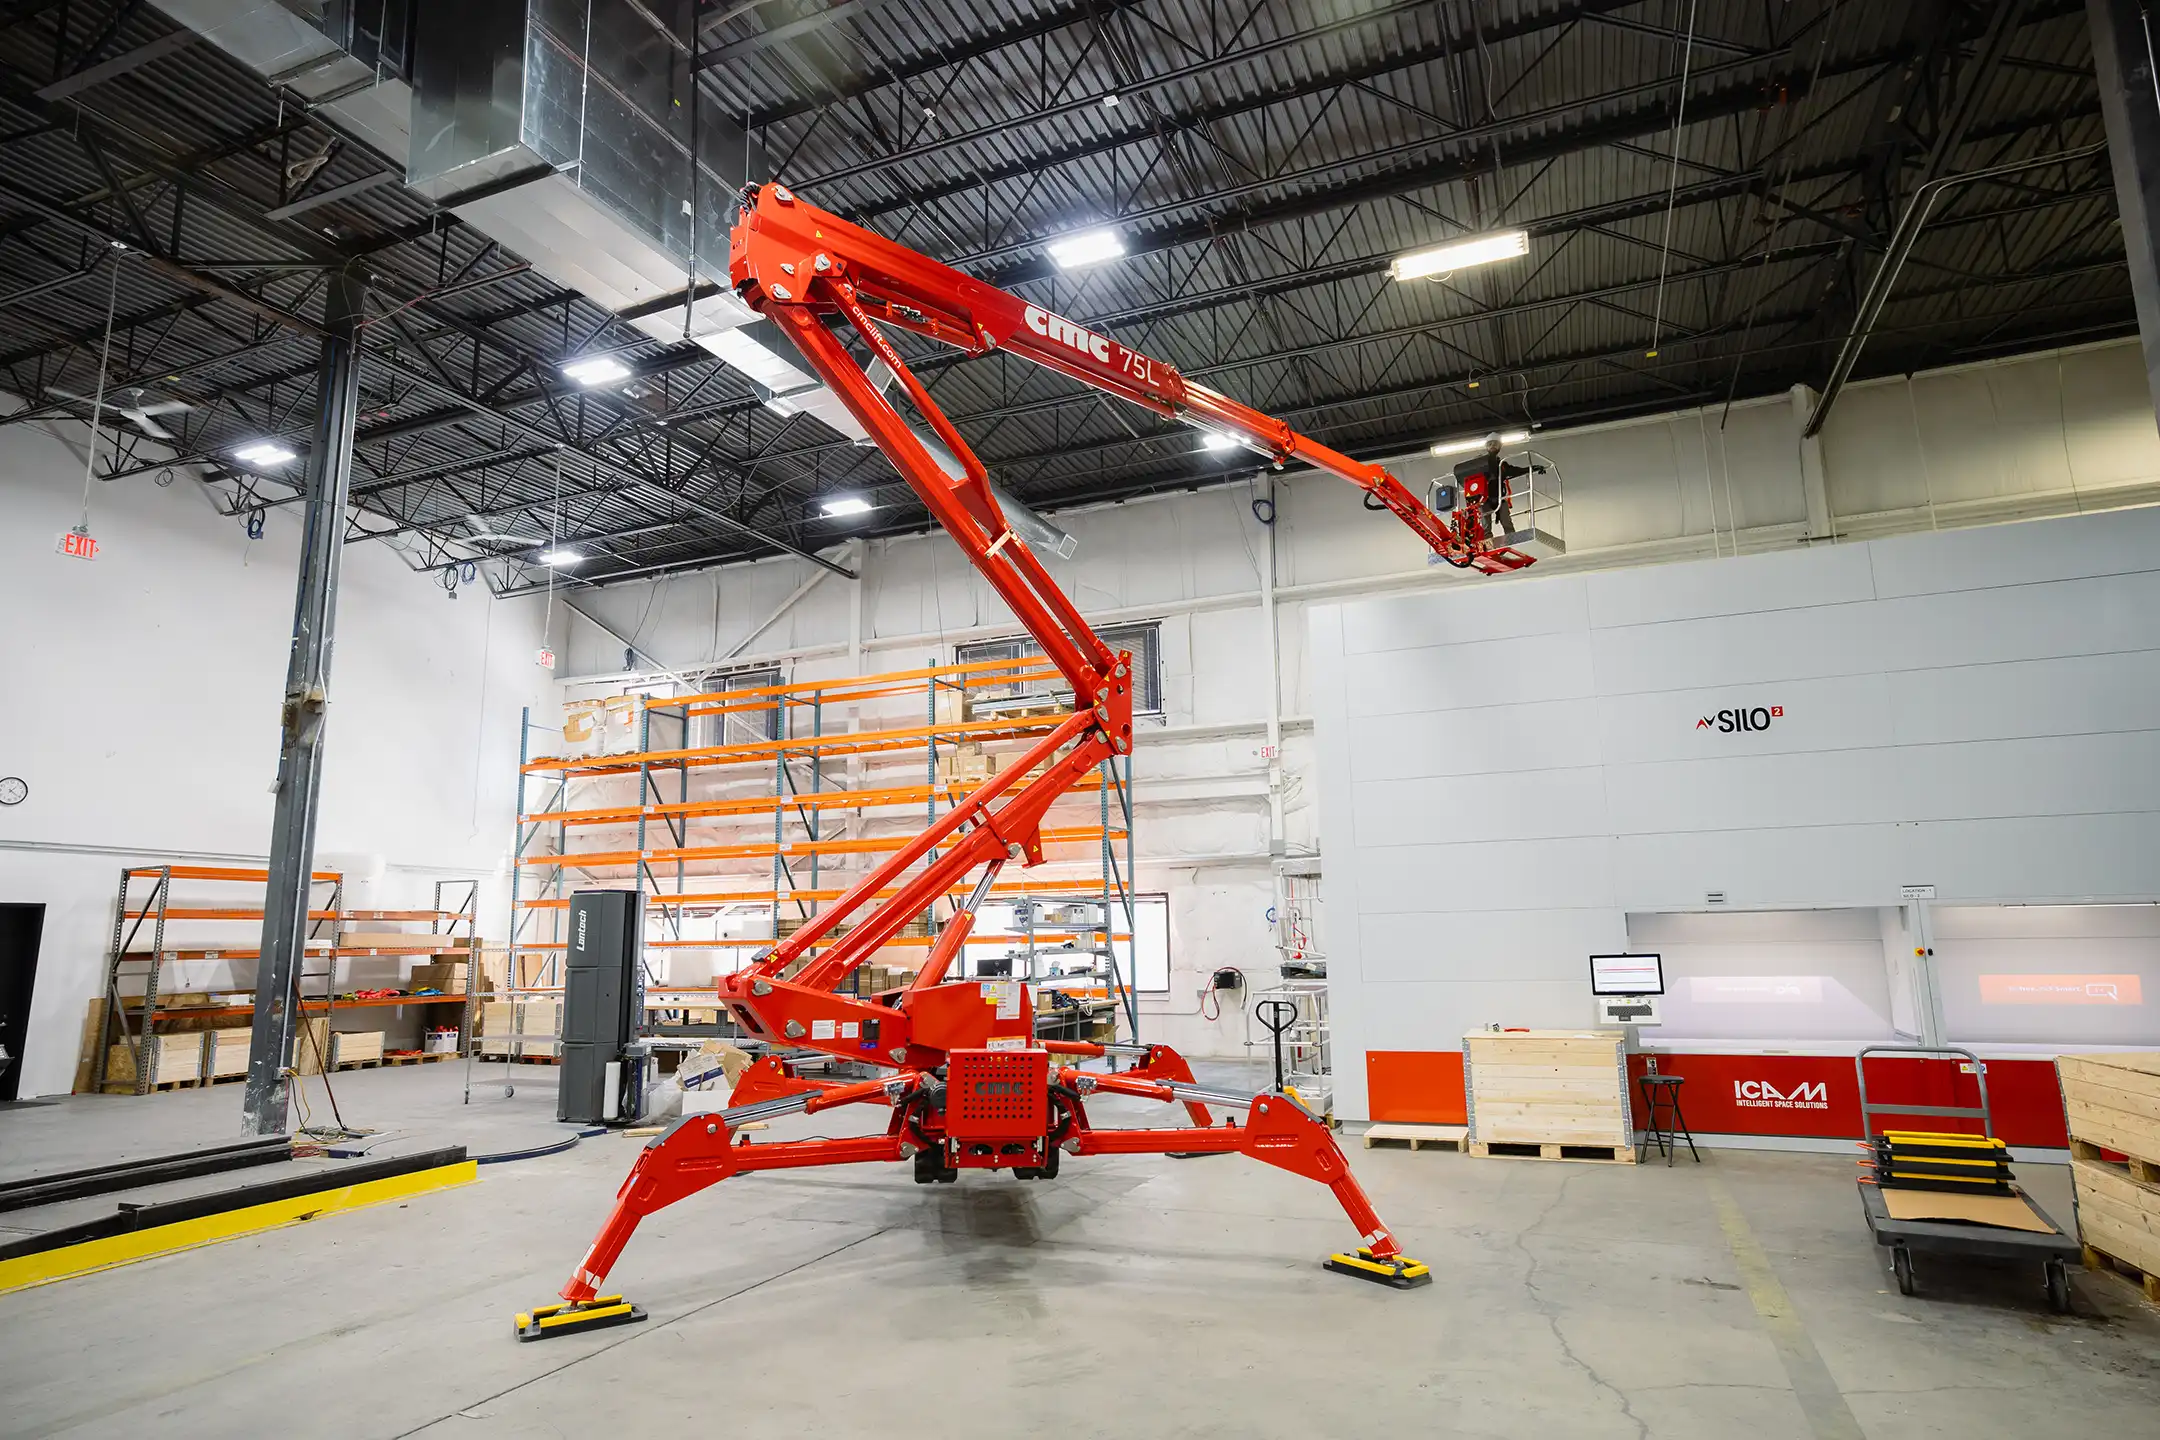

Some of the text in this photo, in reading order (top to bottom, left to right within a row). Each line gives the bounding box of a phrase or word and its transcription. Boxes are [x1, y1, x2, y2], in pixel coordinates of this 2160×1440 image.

[852, 306, 902, 368] cmclift.com
[1024, 305, 1160, 387] cmc 75L
[65, 533, 97, 558] EXIT
[541, 651, 553, 667] EXIT
[1261, 746, 1275, 758] EXIT
[975, 1081, 1024, 1095] cmc
[1734, 1080, 1827, 1101] ICAM
[1736, 1100, 1828, 1109] INTELLIGENT SPACE SOLUTIONS
